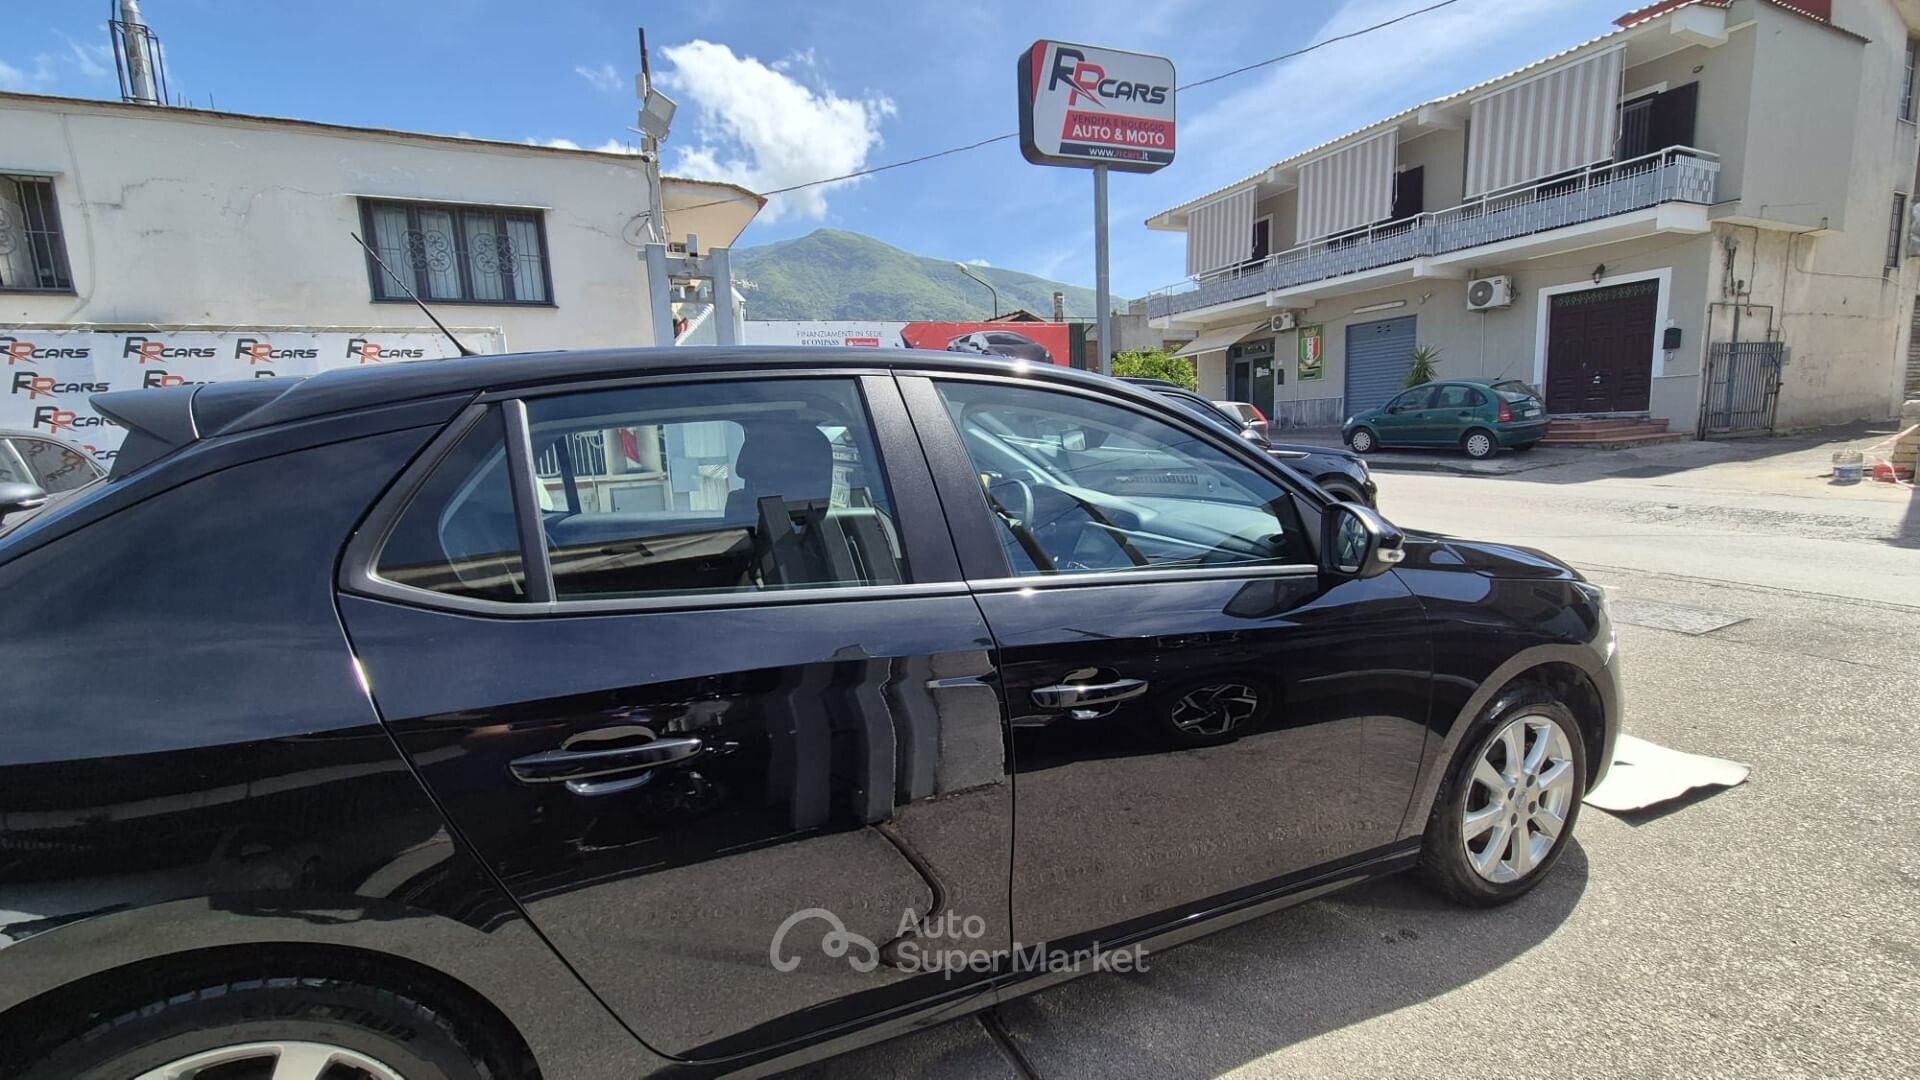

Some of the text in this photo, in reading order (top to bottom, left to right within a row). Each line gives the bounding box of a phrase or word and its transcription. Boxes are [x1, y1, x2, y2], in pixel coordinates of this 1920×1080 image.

[1072, 114, 1112, 126] VENDITA
[1121, 120, 1165, 132] NOLEGGIO
[1072, 124, 1165, 145] AUTO & MOTO
[796, 330, 854, 338] FINANZIAMENTI
